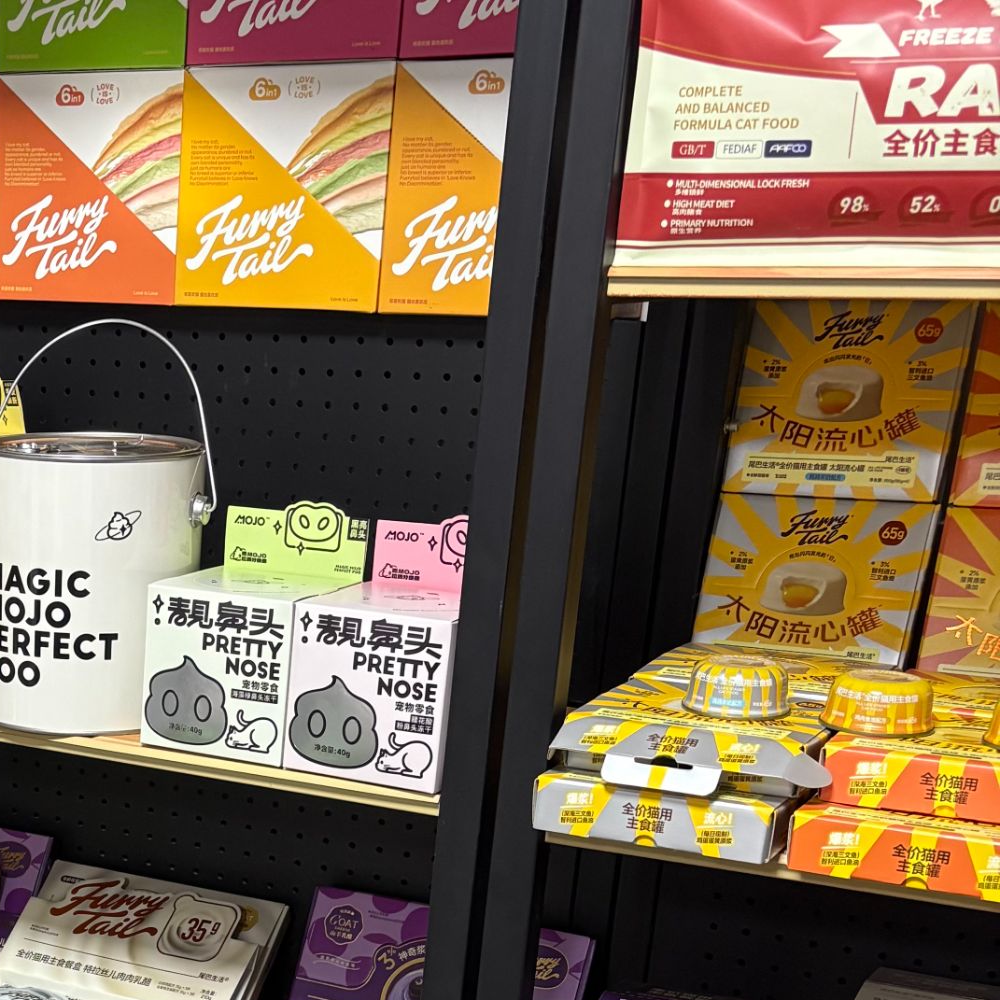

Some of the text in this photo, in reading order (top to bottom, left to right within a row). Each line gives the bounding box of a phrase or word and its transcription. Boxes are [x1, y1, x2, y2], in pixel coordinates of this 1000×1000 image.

[899, 27, 994, 48] FREEZE
[679, 86, 743, 98] COMPLETE
[675, 102, 770, 114] AND BALANCED
[674, 118, 799, 130] FORMULA CAT FOOD
[679, 144, 706, 156] GB/T
[722, 143, 757, 154] FEDIAF
[676, 179, 809, 188] MULTI-DIMENSIONAL LOCK FRESH
[673, 200, 735, 208] HIGH MEAT DIET
[2, 195, 109, 266] Furry
[707, 219, 753, 227] NUTRITION
[186, 195, 305, 271] Furry
[26, 231, 117, 280] Tail
[212, 232, 313, 285] Tail
[815, 312, 886, 344] Furry
[917, 324, 940, 338] 65g
[829, 333, 884, 349] Tail
[752, 404, 921, 452] 太阳流心罐
[234, 515, 266, 526] MOJO
[781, 510, 849, 538] Furry
[385, 531, 418, 542] MOJO
[800, 532, 848, 546] Tail
[881, 527, 904, 539] 65g
[718, 594, 883, 644] 太阳流心罐
[202, 632, 282, 660] PRETTY
[226, 658, 280, 681] NOSE
[353, 652, 440, 680] PRETTY
[242, 681, 278, 693] 宠物零食
[377, 678, 437, 702] NOSE
[395, 702, 434, 715] 宠物零食
[920, 772, 979, 792] 全价猫用
[924, 787, 968, 804] 主食罐
[622, 803, 672, 821] 全价猫用
[626, 816, 665, 833] 主食罐
[892, 844, 951, 865] 全价猫用
[897, 860, 941, 878] 主食罐
[51, 881, 169, 917] Furry
[73, 910, 158, 939] Tail
[181, 917, 219, 943] 35g
